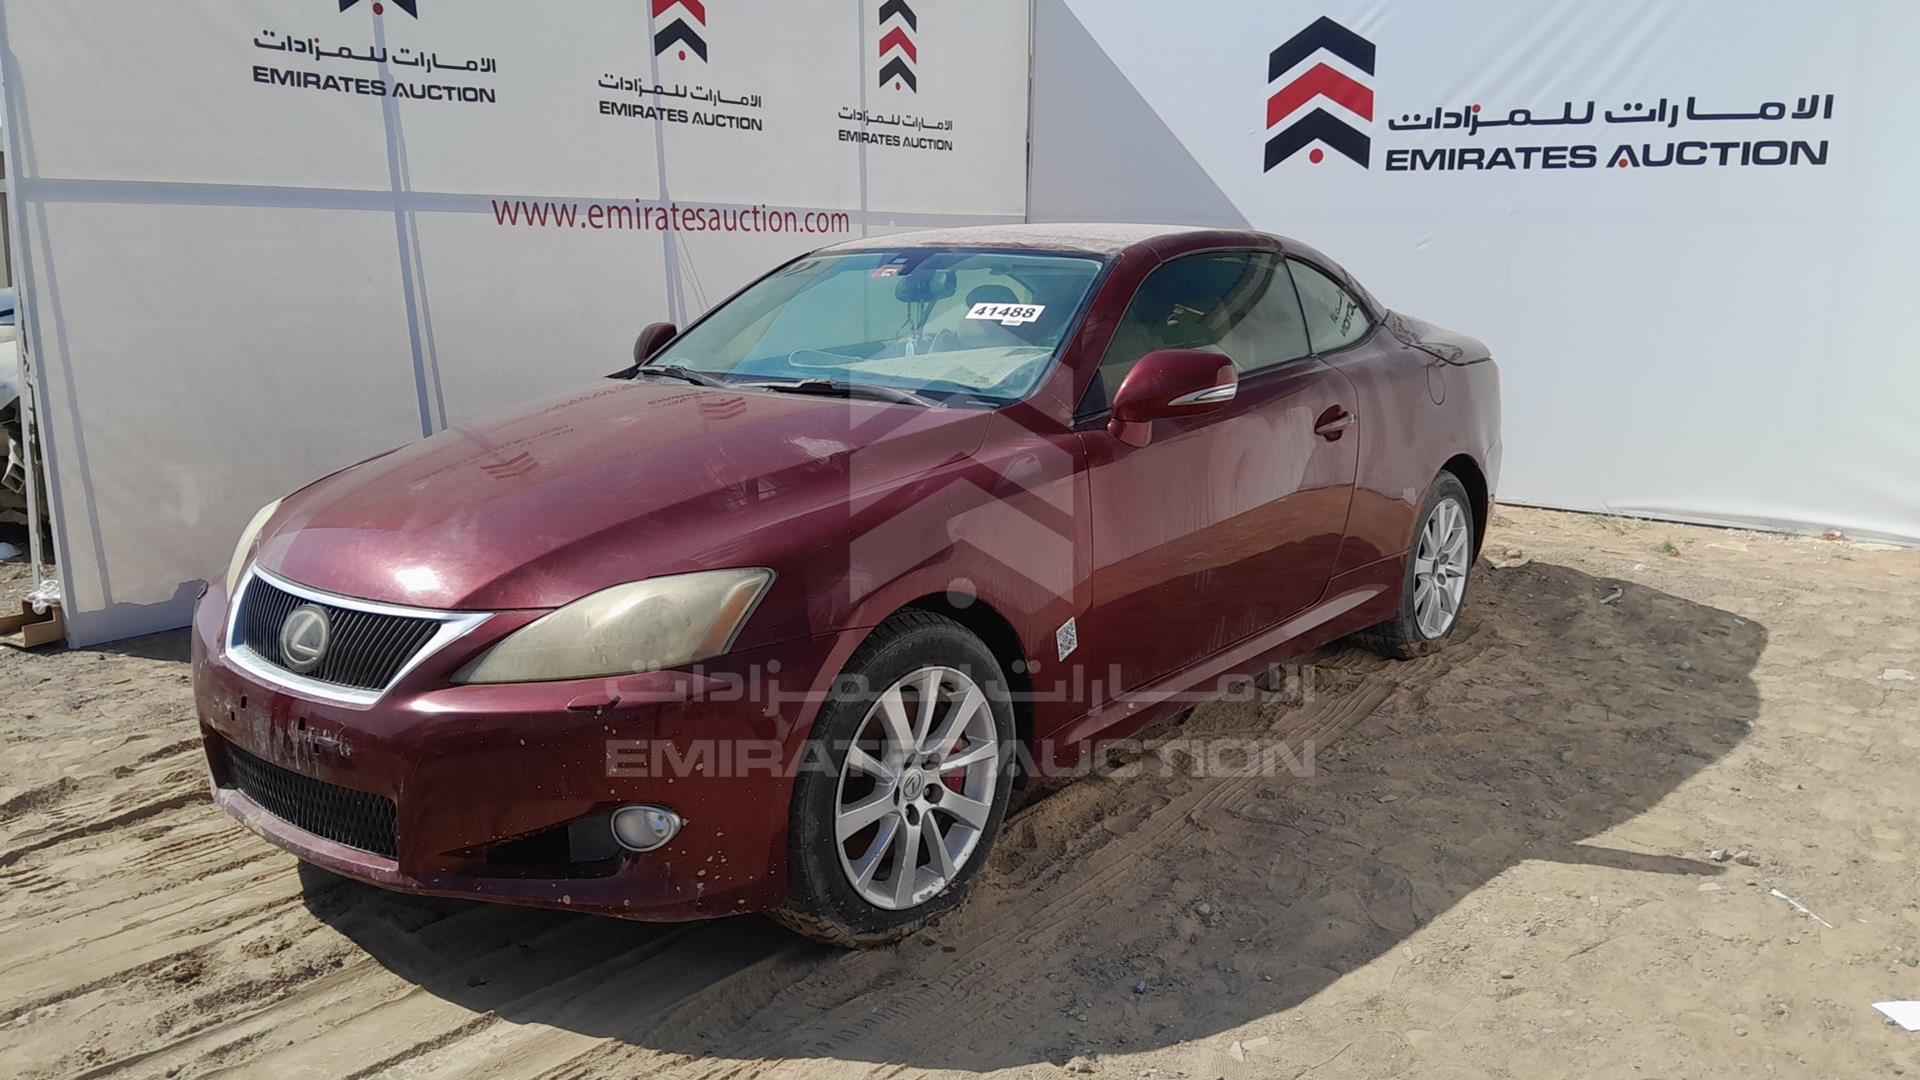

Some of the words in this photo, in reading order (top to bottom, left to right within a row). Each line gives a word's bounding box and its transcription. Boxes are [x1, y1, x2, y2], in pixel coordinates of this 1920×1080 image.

[253, 29, 387, 62] للمزادات
[392, 49, 496, 73] الامارات
[252, 65, 387, 96] EMIRATES
[392, 82, 496, 103] AUCTION
[598, 73, 687, 98] للمزادات
[690, 86, 762, 108] الامارات
[599, 100, 688, 123] EMIRATES
[692, 112, 763, 131] AUCTION
[1388, 101, 1594, 135] للمزادات
[1604, 94, 1834, 127] الامارات
[838, 129, 901, 148] EMIRATES
[902, 136, 953, 151] AUCTION
[1385, 144, 1597, 171] EMIRATES
[1606, 140, 1829, 169] AUCTION
[491, 198, 850, 233] www.emiratesauction.com
[974, 306, 1036, 318] 41488
